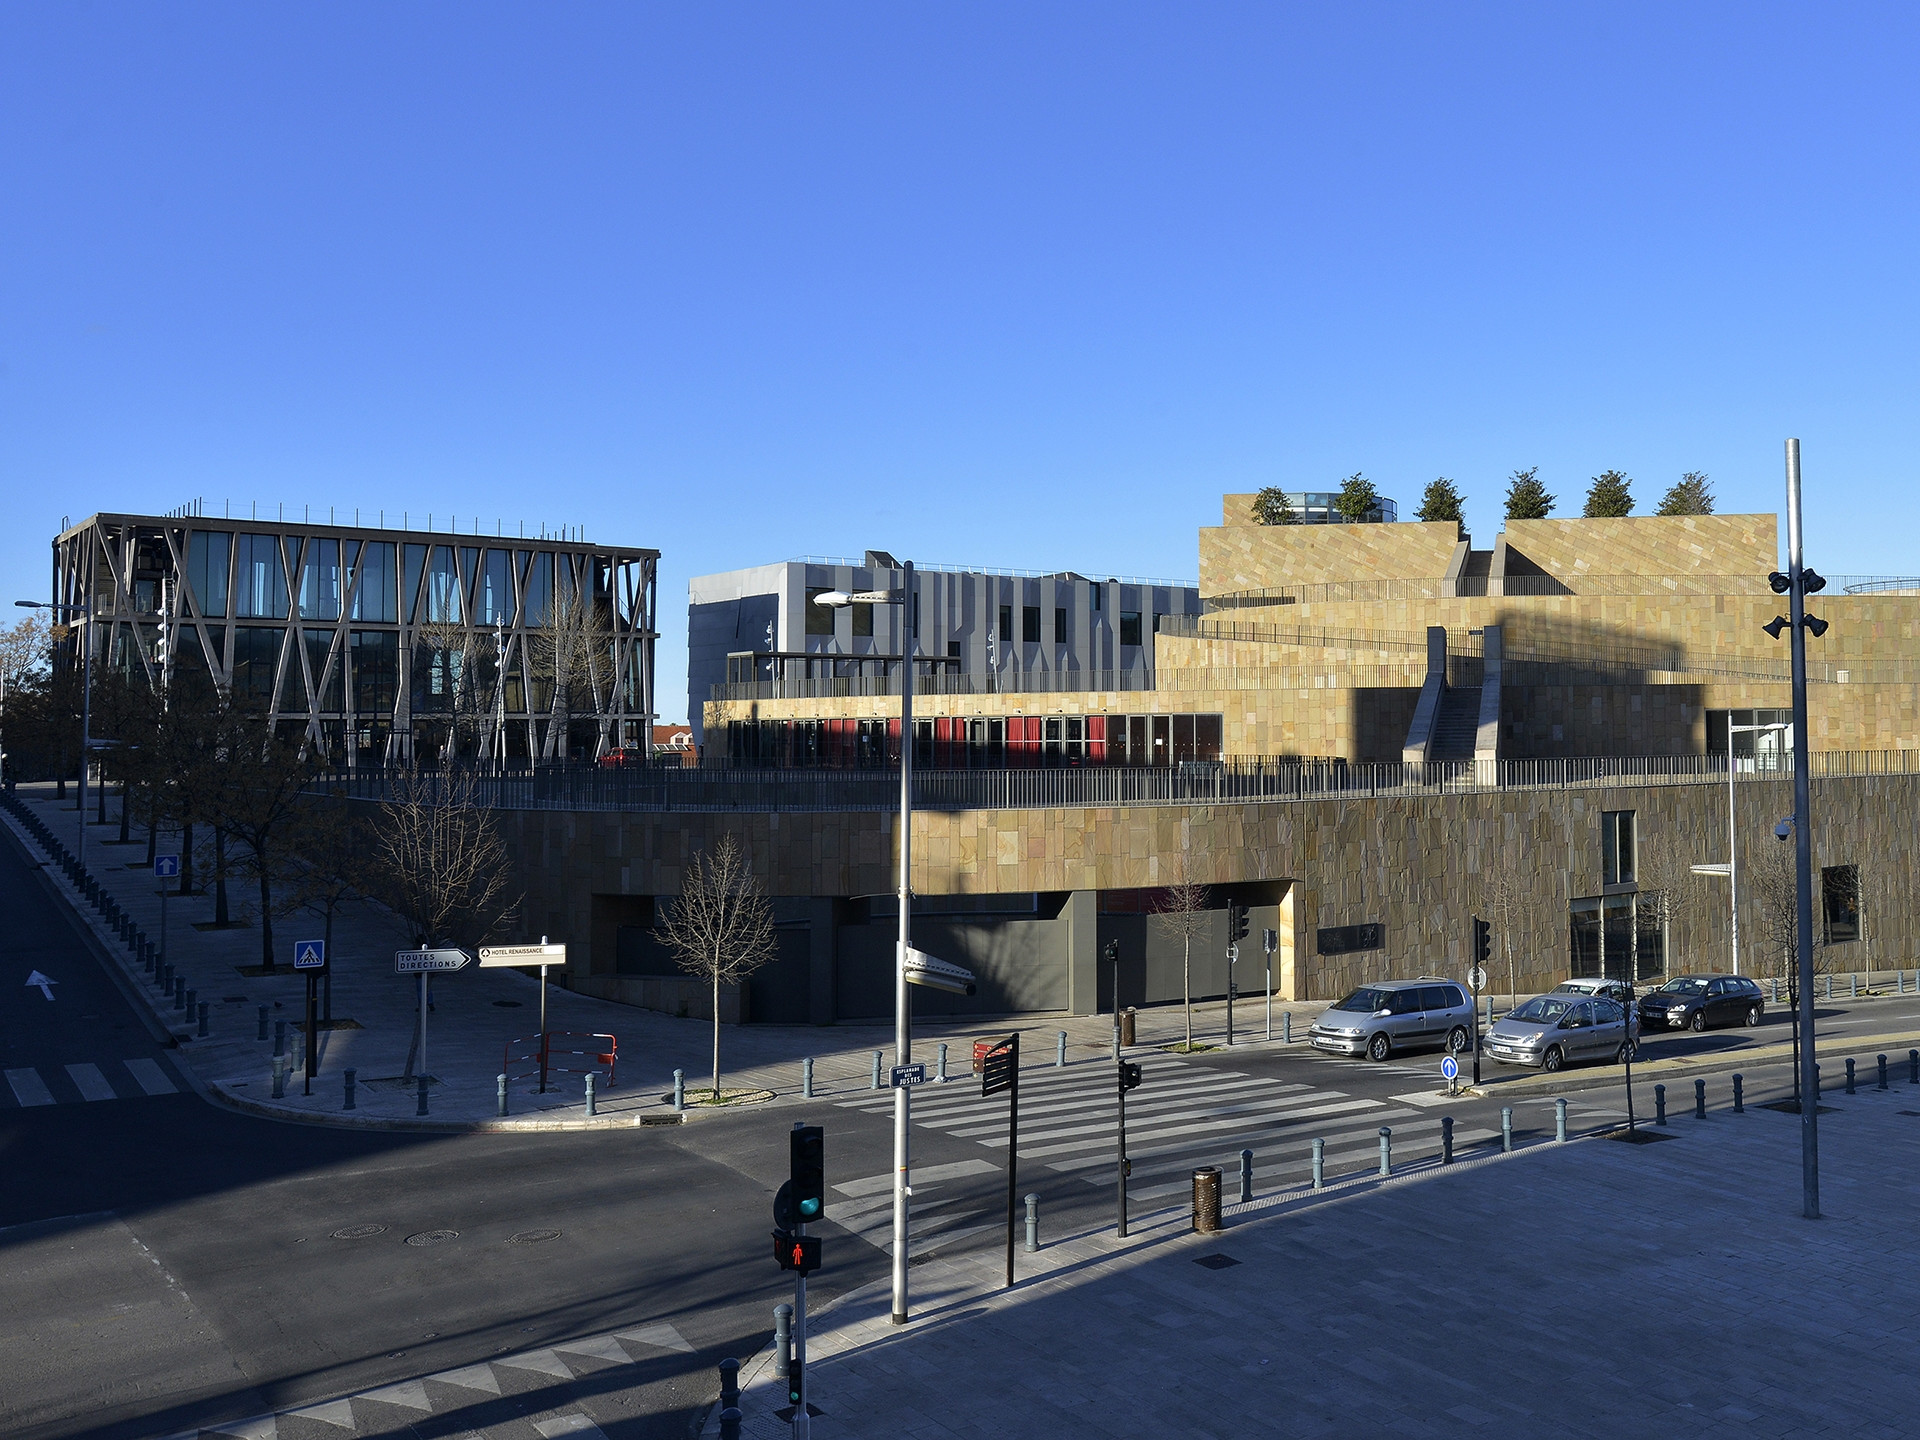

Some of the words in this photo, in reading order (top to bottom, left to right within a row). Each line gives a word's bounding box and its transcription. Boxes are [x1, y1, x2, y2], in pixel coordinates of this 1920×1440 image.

[508, 947, 543, 955] RENAISSANCE
[400, 953, 435, 962] TOUTES
[400, 960, 457, 970] DIRECTIONS
[900, 1076, 920, 1085] JUSTES
